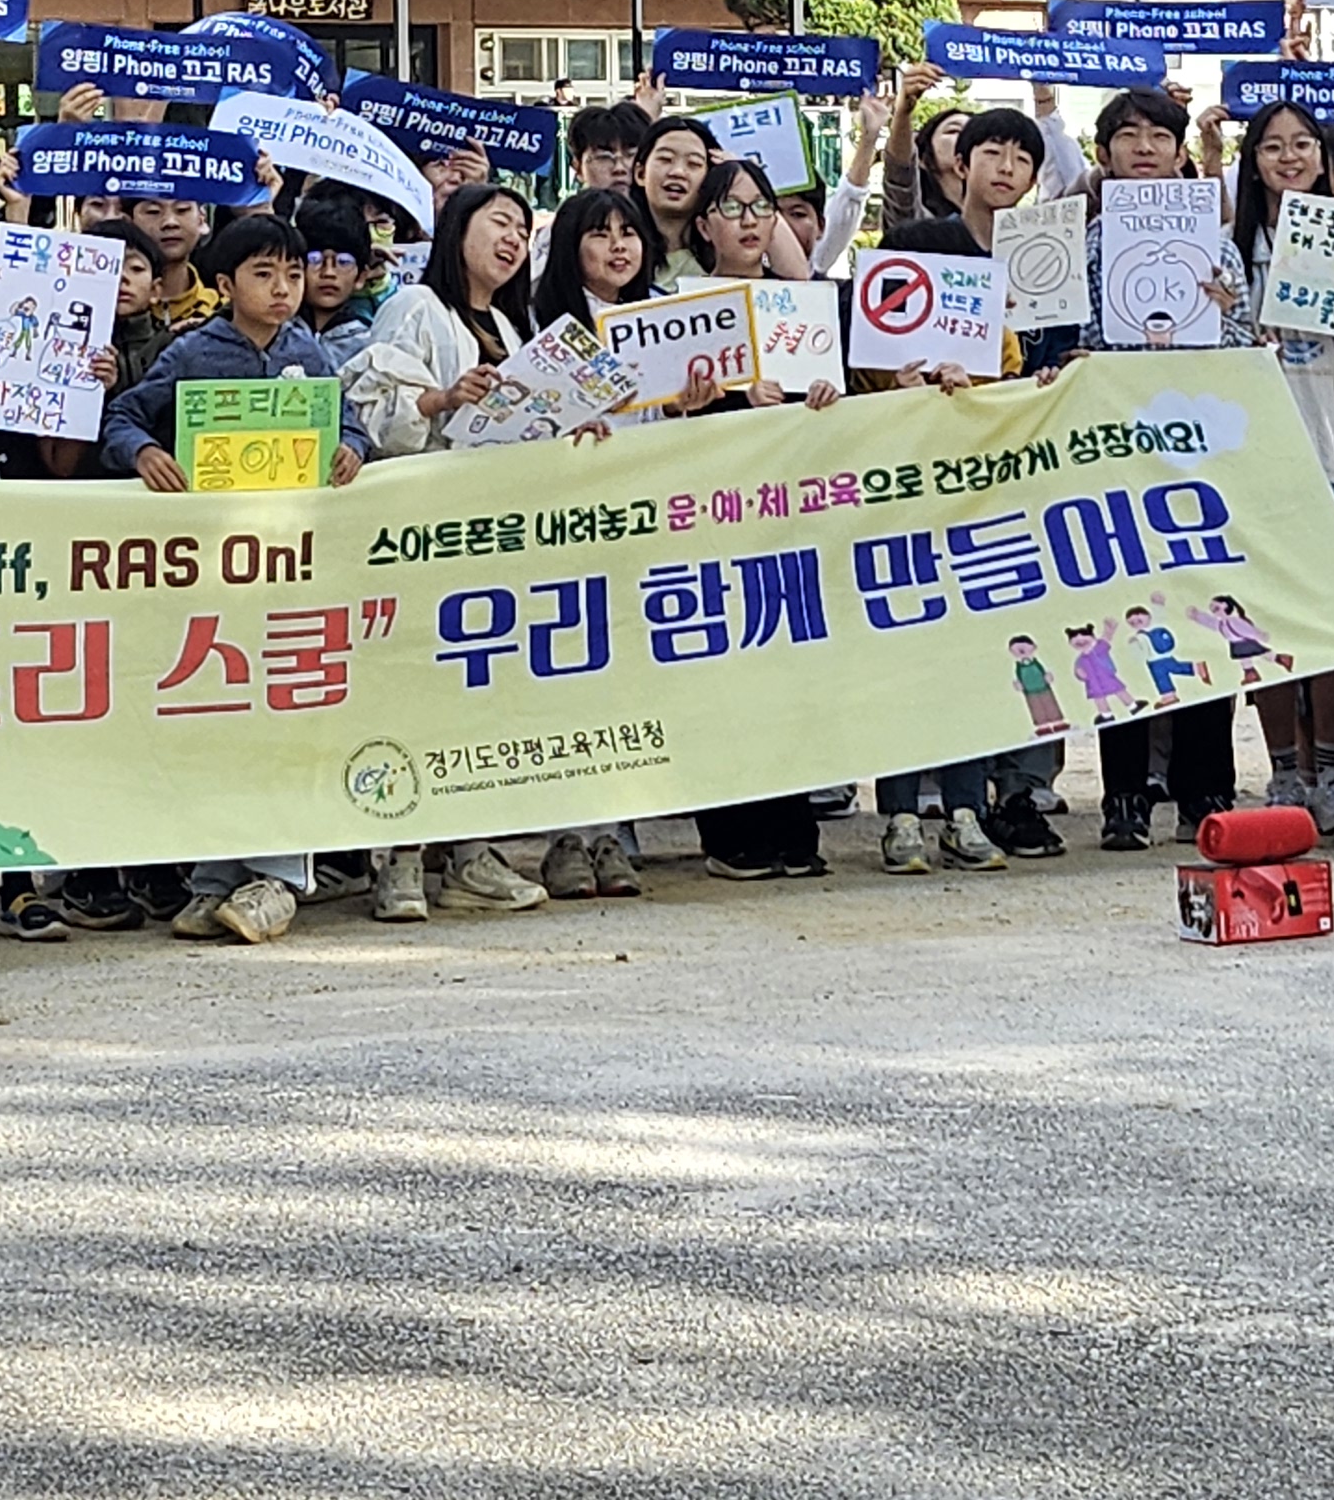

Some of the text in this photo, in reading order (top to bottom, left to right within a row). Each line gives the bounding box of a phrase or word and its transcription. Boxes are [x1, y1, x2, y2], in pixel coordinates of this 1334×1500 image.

[114, 57, 176, 77] Phone
[181, 60, 223, 81] 끄고
[227, 63, 272, 84] RAS
[720, 55, 779, 74] Phone
[783, 58, 817, 76] 끄고
[822, 60, 861, 77] RAS
[996, 47, 1059, 68] Phone
[1064, 52, 1103, 71] 끄고
[1105, 57, 1147, 72] RAS
[290, 127, 359, 158] Phone
[406, 111, 542, 152] Phone RAS
[83, 151, 243, 182] Phone 끄고 RAS
[609, 306, 737, 354] Phone
[687, 343, 749, 380] Off
[535, 500, 659, 548] 내려놓고
[799, 463, 923, 513] 교육으로
[933, 439, 1059, 496] 건강하게
[1068, 420, 1209, 465] 성장해요!
[69, 537, 200, 591] RAS
[221, 531, 315, 583] On!
[156, 598, 397, 718] 스쿨”
[436, 575, 611, 689] 우리
[640, 548, 828, 665] 함께
[853, 480, 1246, 631] 만들어요
[425, 720, 665, 779] 경기도양평교육지원청
